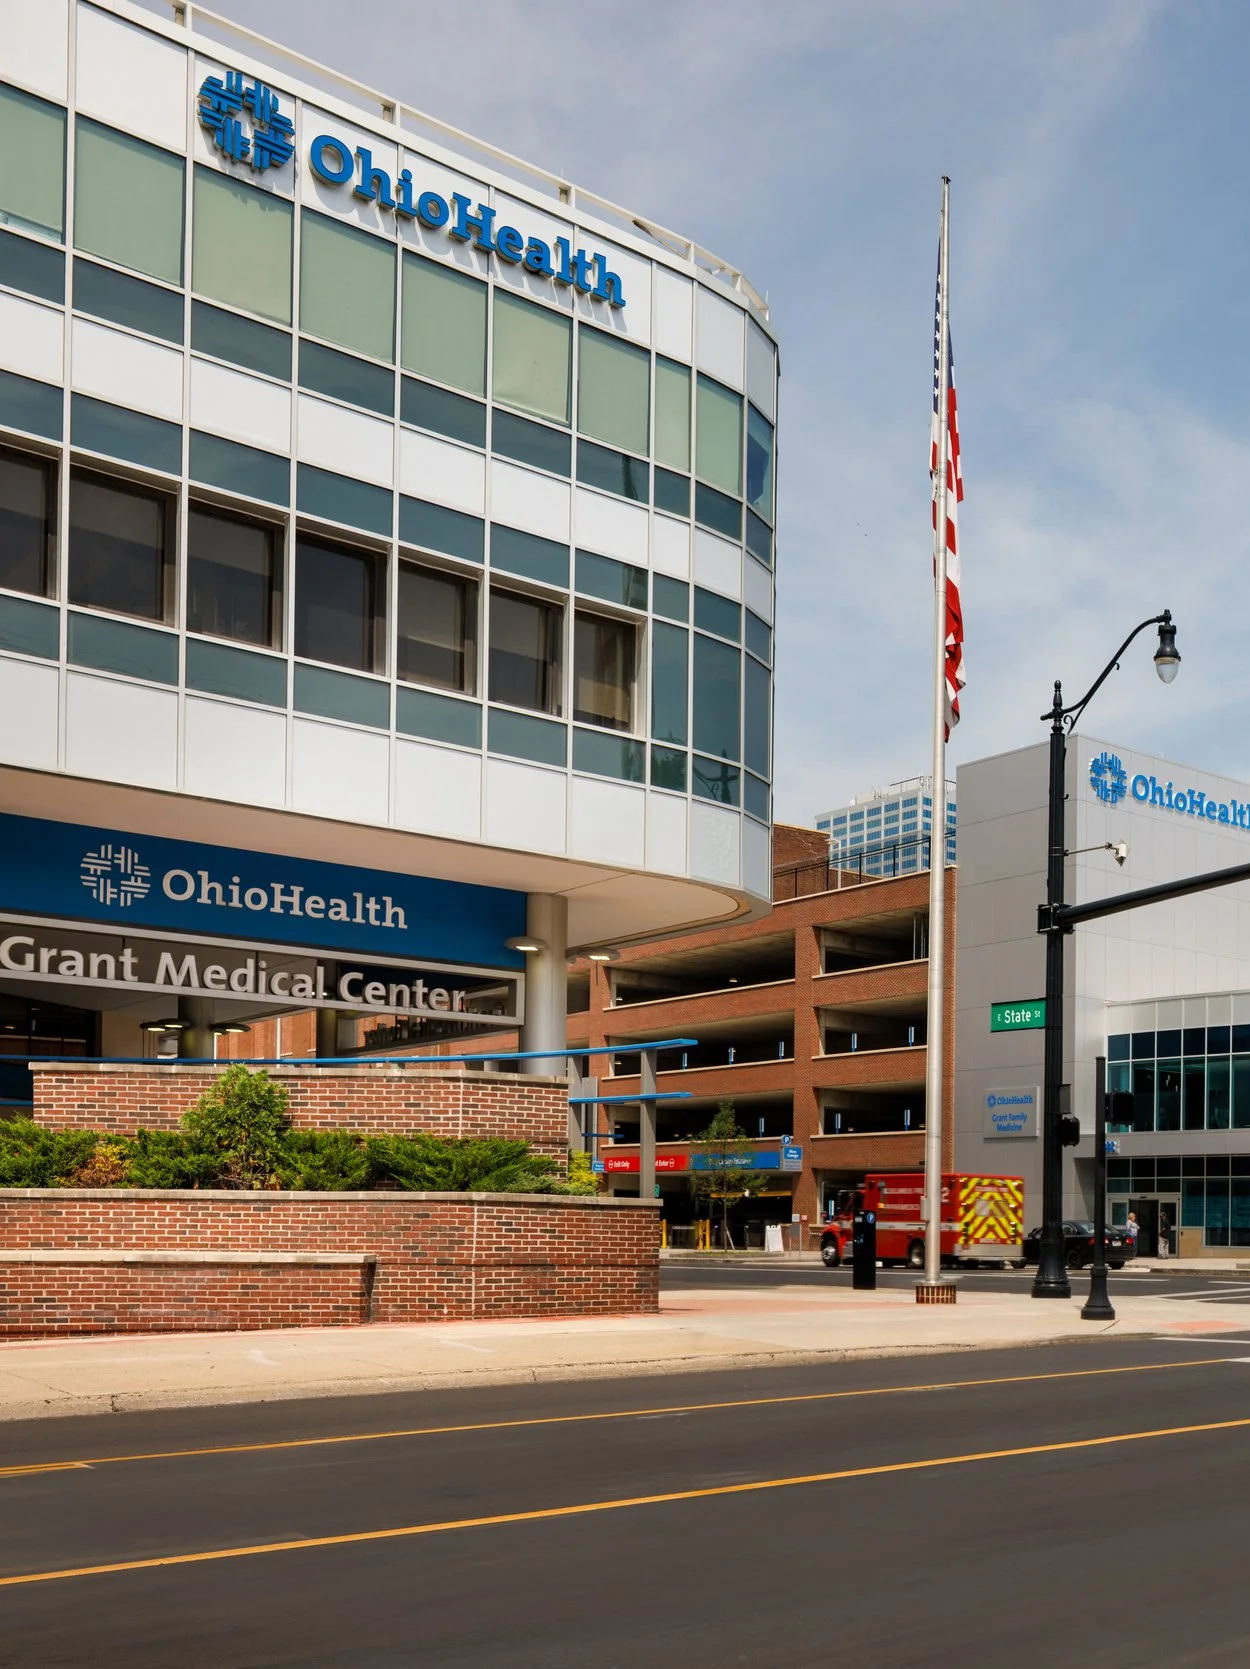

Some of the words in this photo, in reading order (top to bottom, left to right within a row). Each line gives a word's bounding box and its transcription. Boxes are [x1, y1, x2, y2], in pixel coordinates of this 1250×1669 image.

[310, 134, 626, 309] OhioHealth
[162, 869, 408, 929] OhioHealth
[0, 936, 139, 982] Grant
[155, 951, 325, 1000] Medical
[339, 972, 466, 1012] Center
[997, 1013, 1001, 1021] E
[1004, 1009, 1031, 1024] State
[997, 1094, 1033, 1105] OhioHealth
[992, 1113, 1008, 1122] Grant
[1009, 1112, 1027, 1123] Family
[621, 1160, 630, 1169] Only
